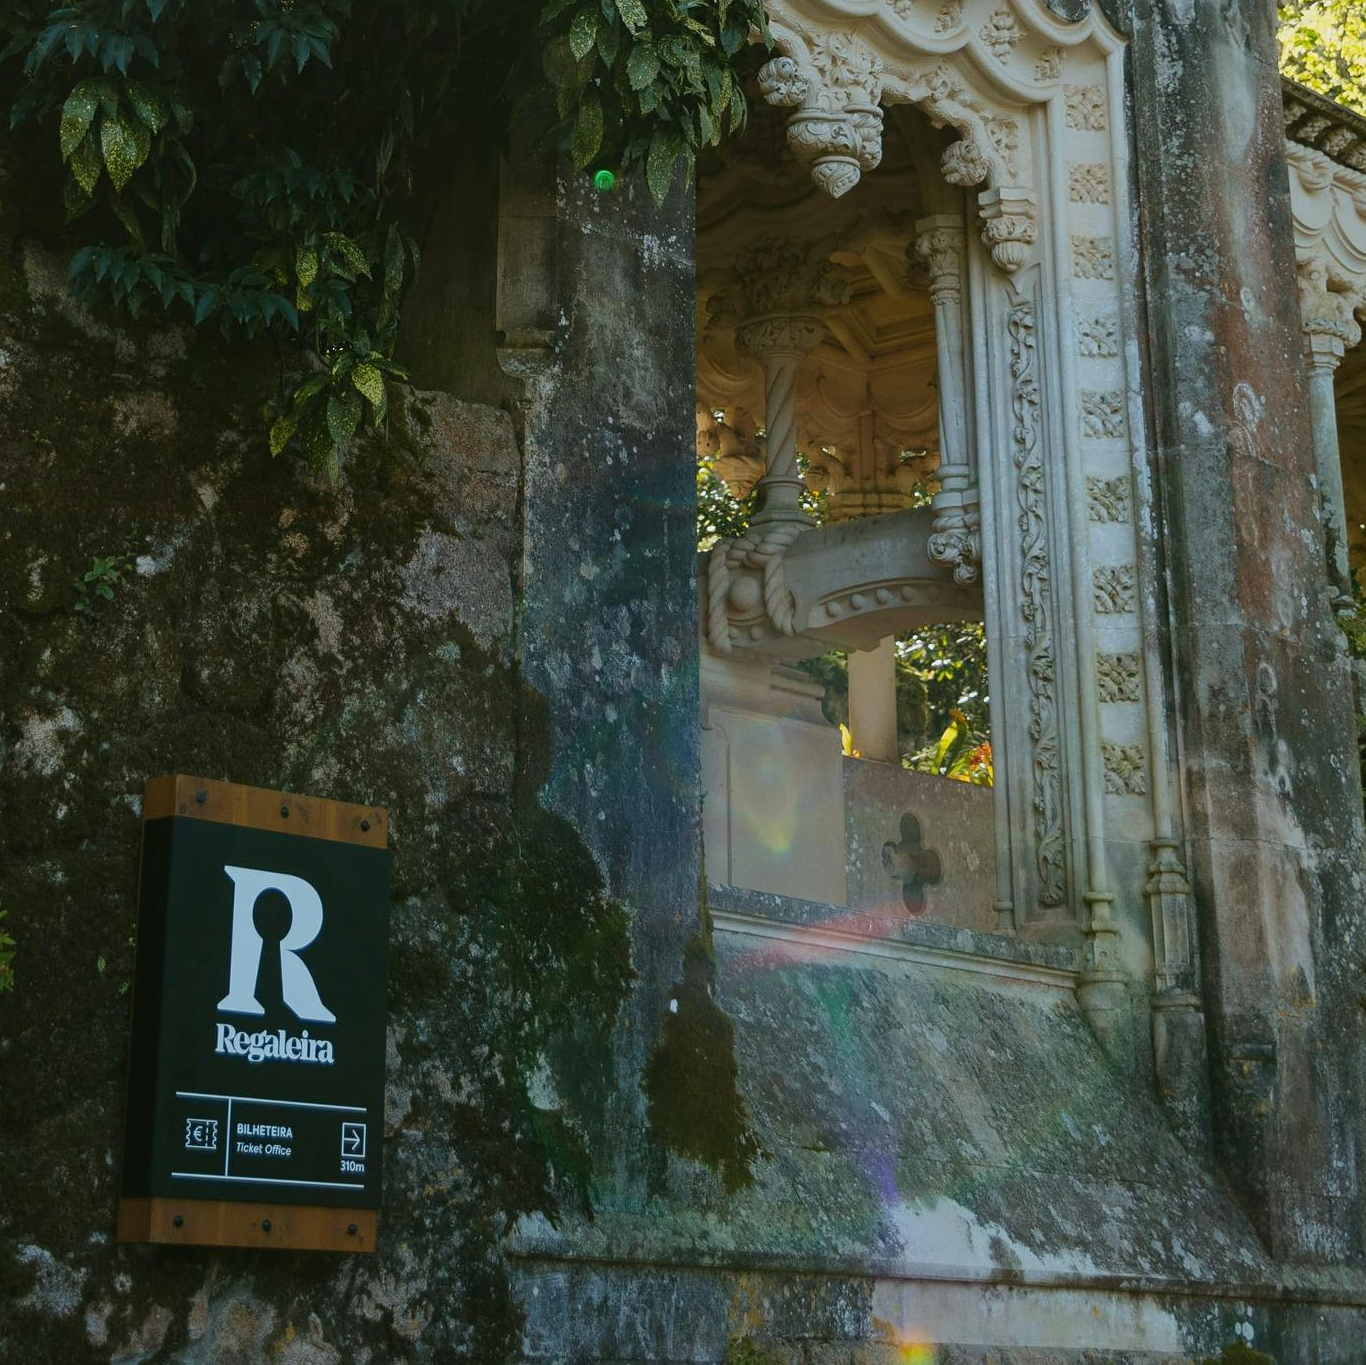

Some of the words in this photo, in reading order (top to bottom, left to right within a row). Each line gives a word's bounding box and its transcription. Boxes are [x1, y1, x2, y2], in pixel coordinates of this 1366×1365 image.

[217, 864, 337, 1022] R
[215, 1022, 335, 1064] Regaleira
[236, 1123, 293, 1139] BILHETEIRA
[236, 1141, 263, 1155] Ticket
[265, 1143, 292, 1156] Office
[340, 1160, 365, 1173] 310m
